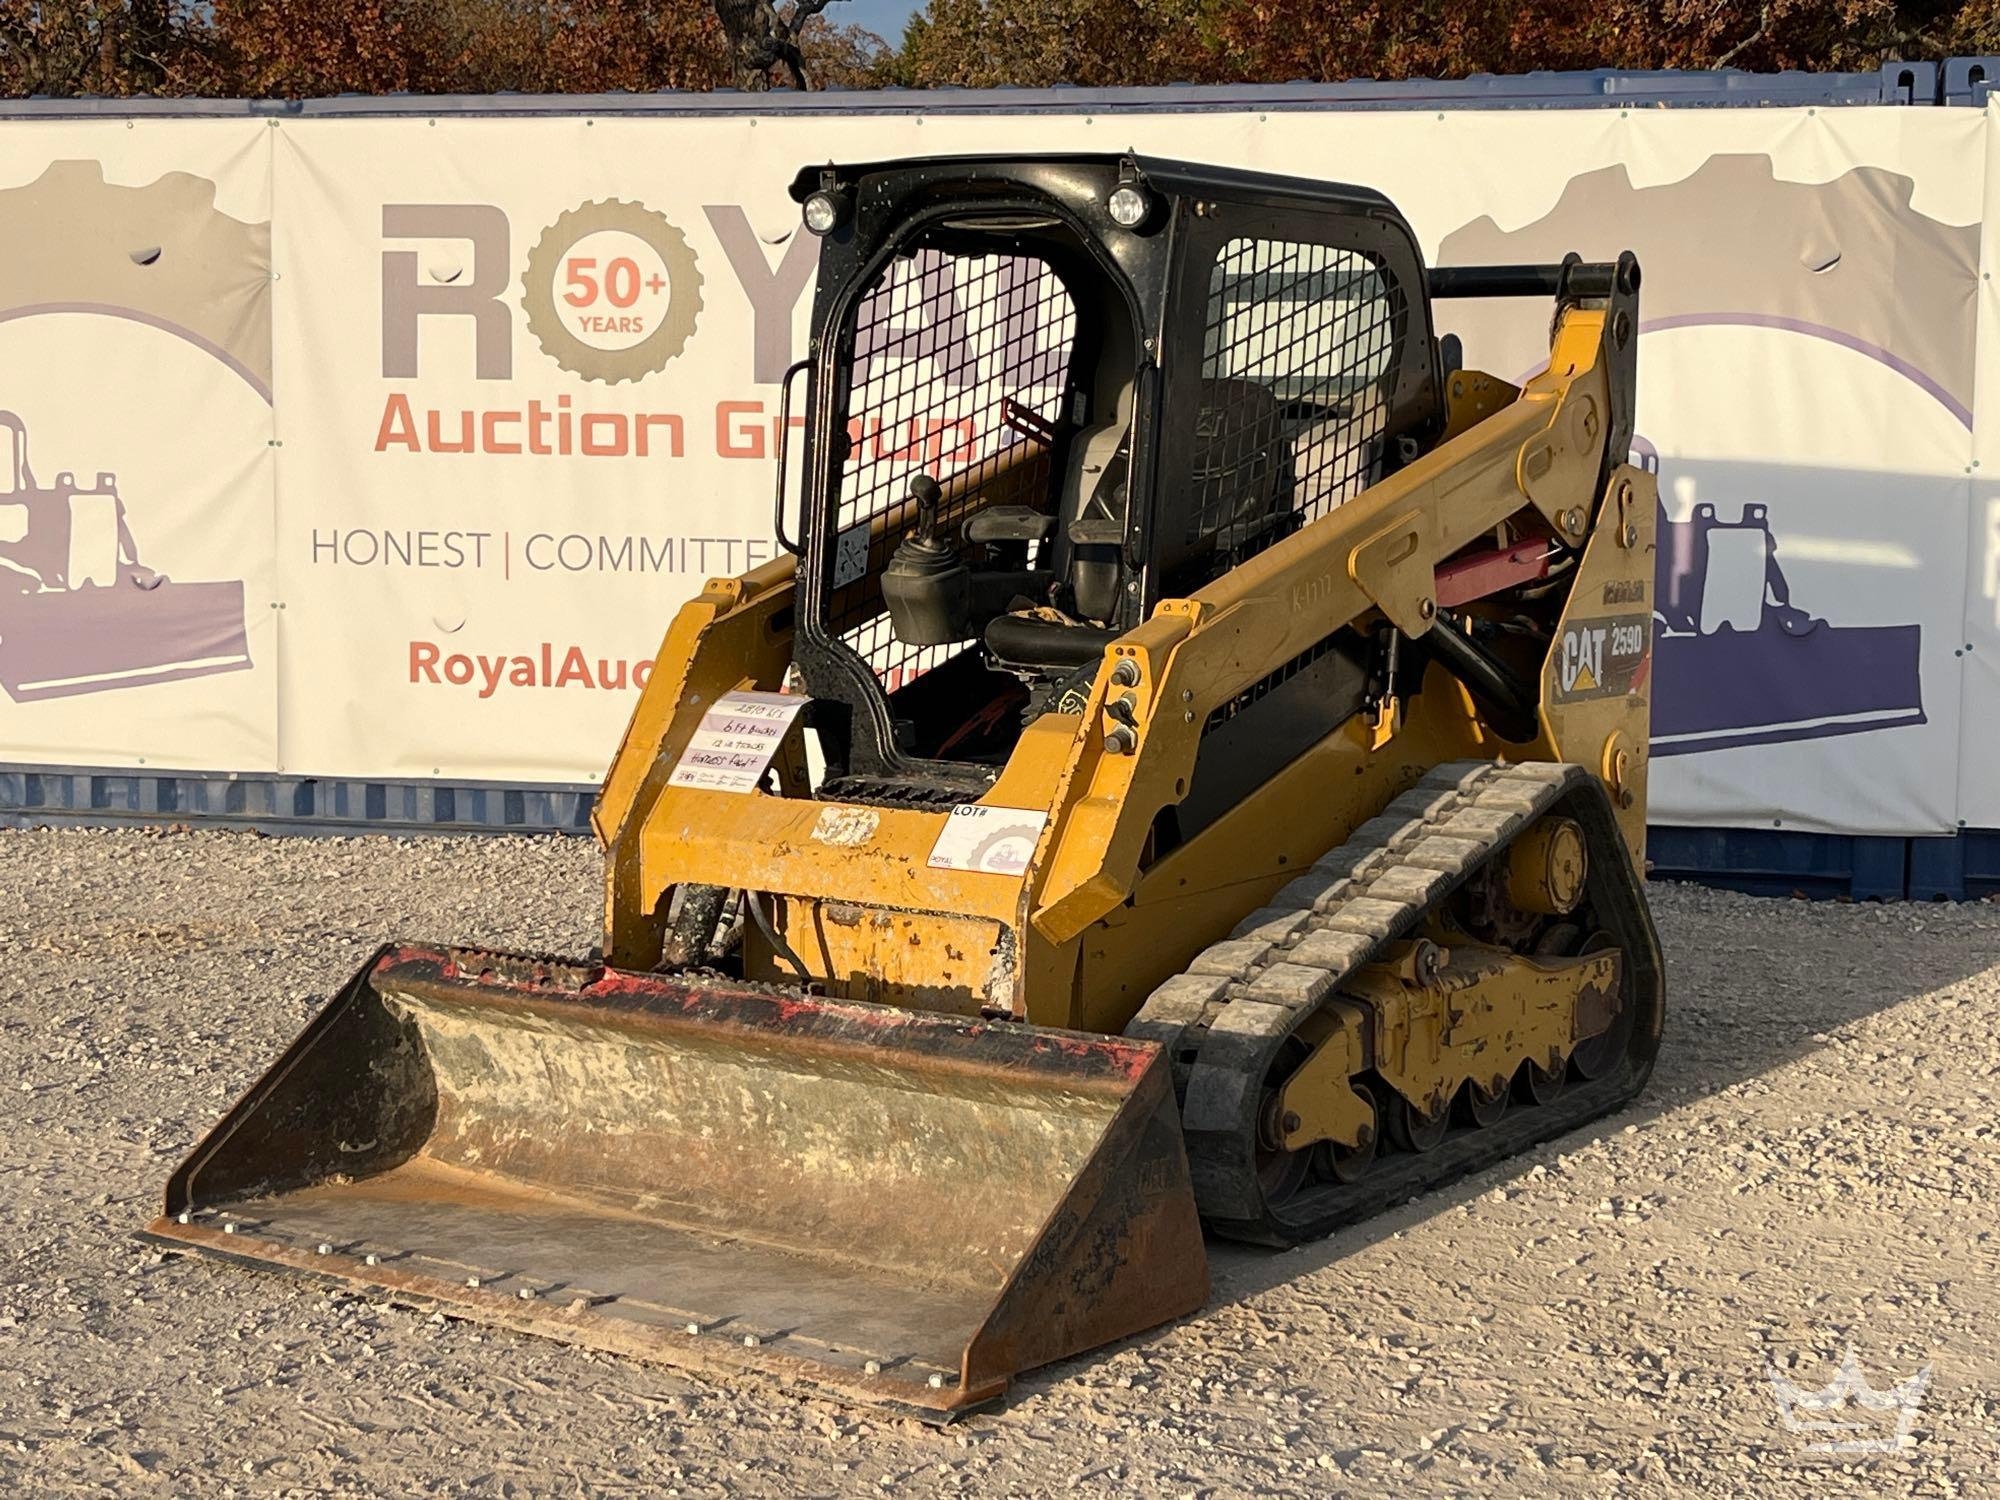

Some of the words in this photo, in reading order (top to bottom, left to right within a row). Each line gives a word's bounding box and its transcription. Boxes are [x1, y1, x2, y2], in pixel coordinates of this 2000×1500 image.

[562, 256, 666, 308] 50+
[578, 316, 644, 333] YEARS
[374, 393, 685, 458] Auction
[312, 528, 492, 568] HONEST
[525, 533, 778, 574] COMMITTE
[1561, 627, 1607, 692] CAT
[1611, 625, 1643, 656] 259D
[954, 806, 987, 817] LOT#
